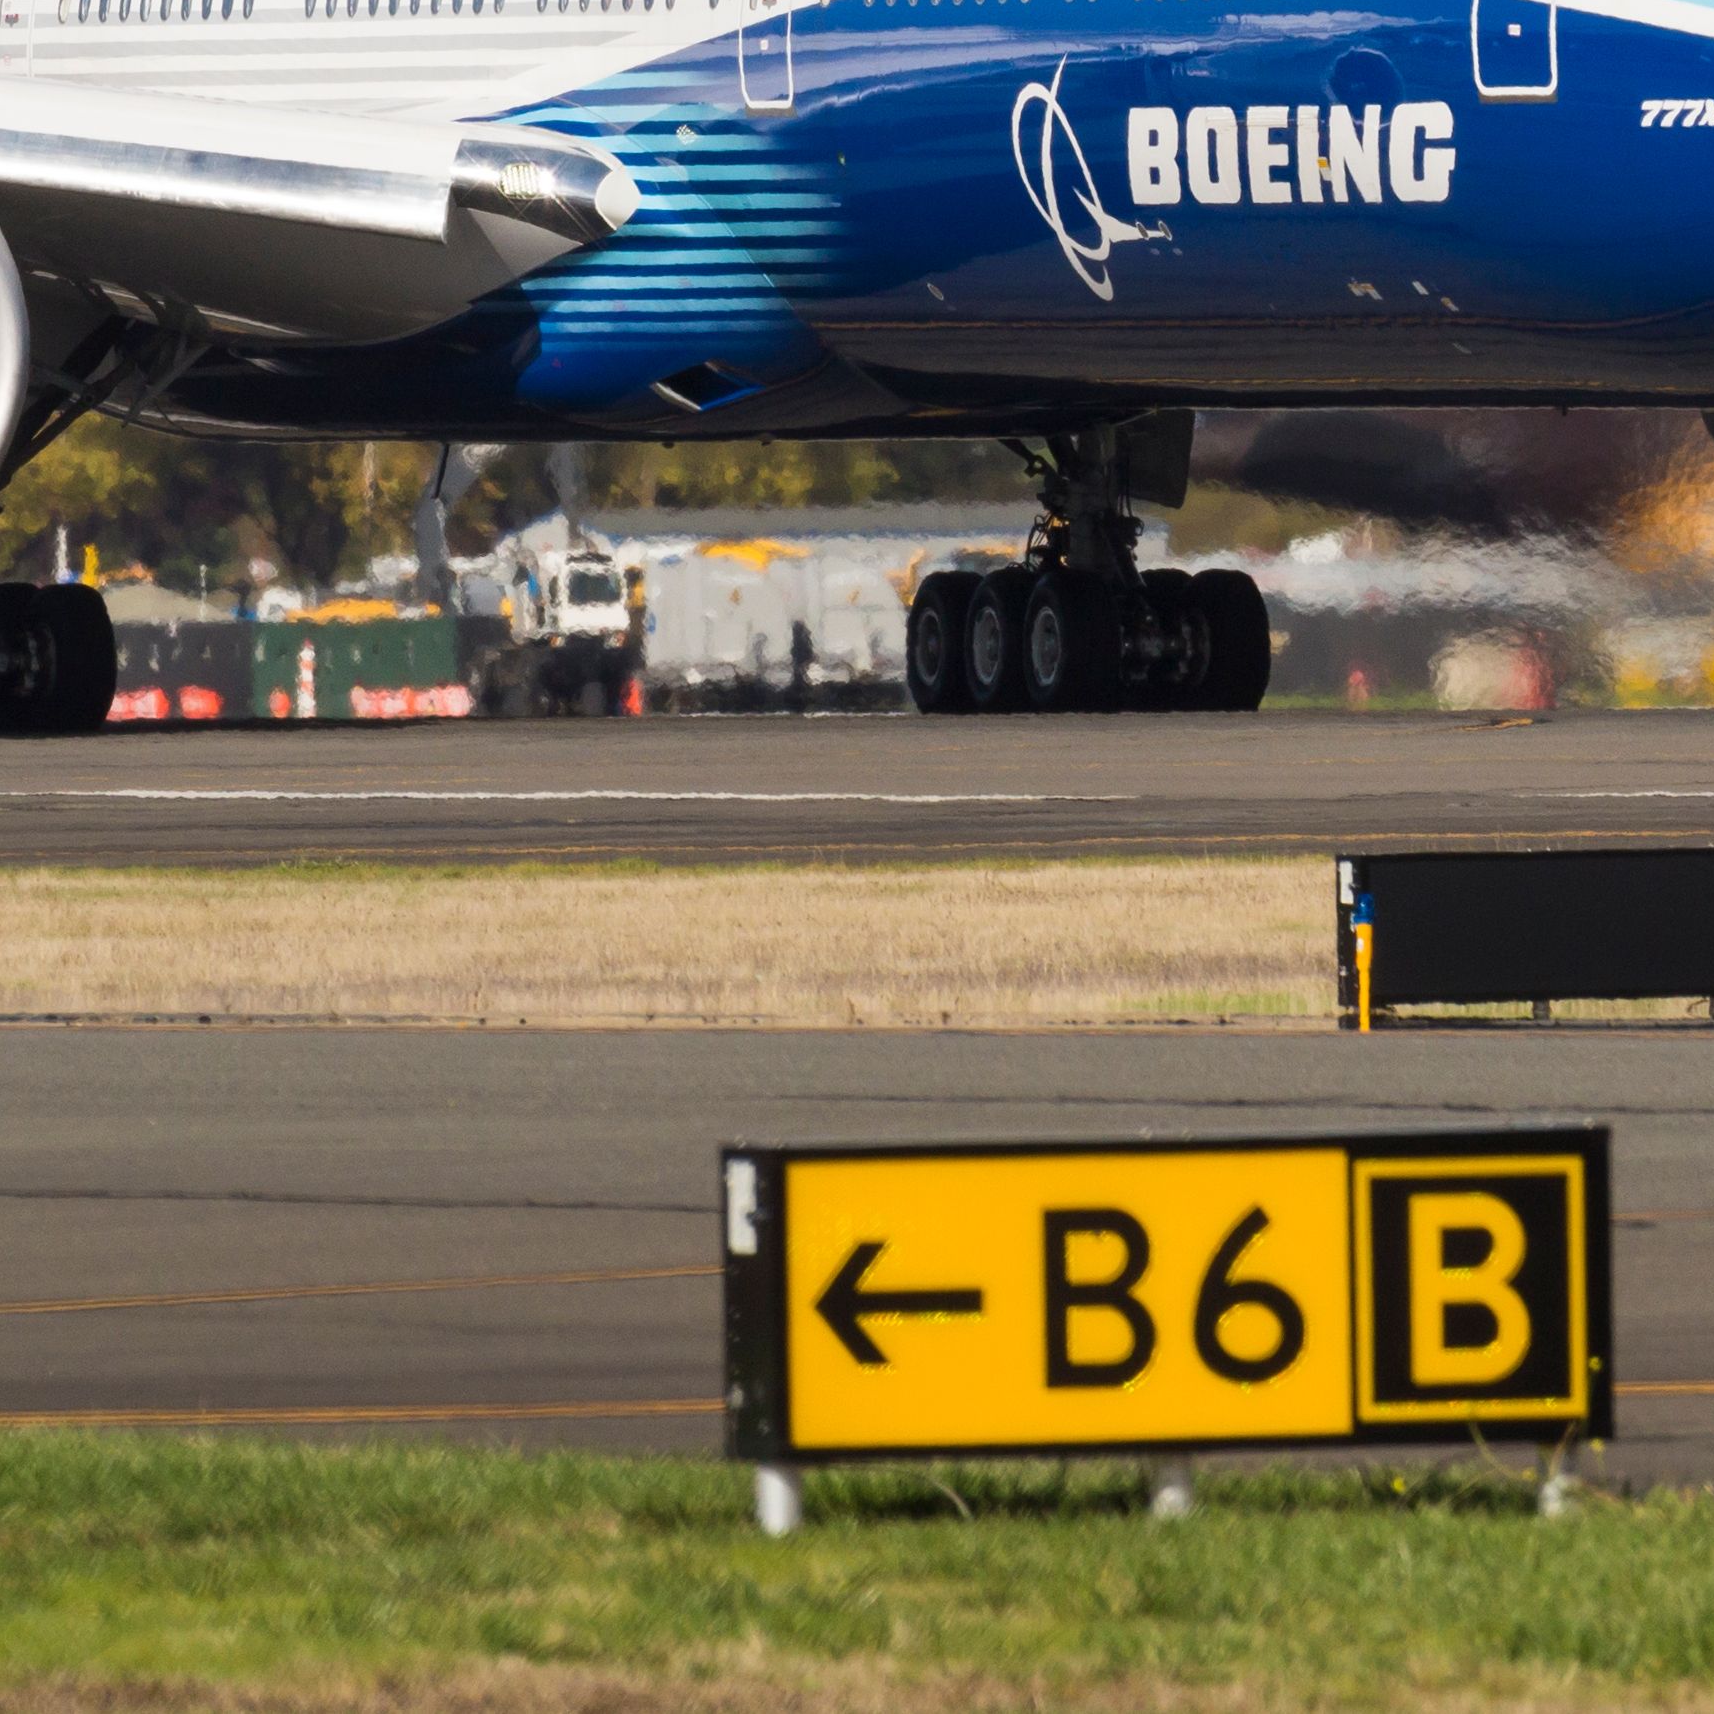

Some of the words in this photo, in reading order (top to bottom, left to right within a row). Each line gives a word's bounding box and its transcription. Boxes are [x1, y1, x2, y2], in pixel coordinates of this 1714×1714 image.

[1126, 101, 1456, 205] BOEING
[1042, 1205, 1306, 1391] B6
[1407, 1191, 1531, 1387] B
